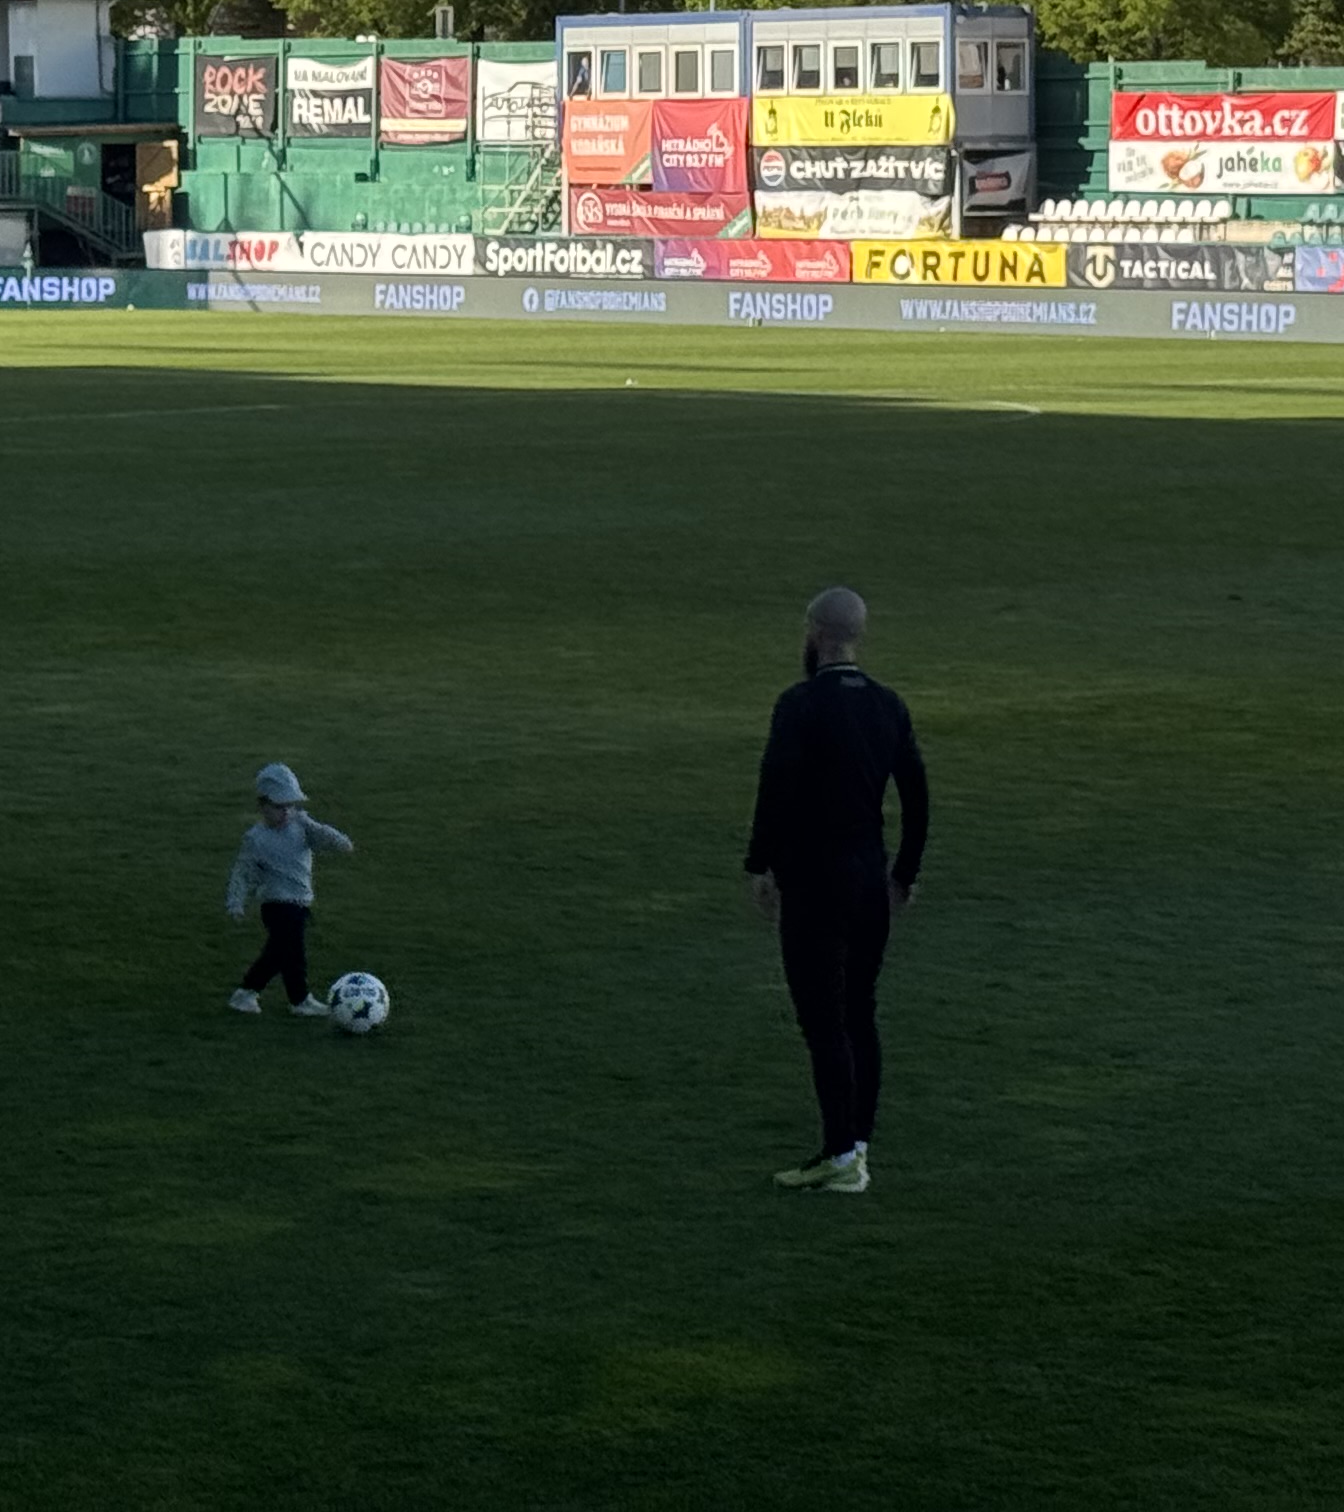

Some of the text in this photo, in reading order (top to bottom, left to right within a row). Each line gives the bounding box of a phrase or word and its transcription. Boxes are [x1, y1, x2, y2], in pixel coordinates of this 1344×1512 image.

[203, 63, 267, 94] ROCK
[204, 94, 266, 116] ZONE
[292, 96, 371, 124] REMAL
[1135, 101, 1310, 137] ottovka.cz
[662, 154, 684, 168] CITY
[708, 154, 725, 168] FM
[910, 157, 945, 181] VÍC
[310, 242, 466, 270] CANDY CANDY
[485, 241, 643, 277] SportFotbal.cz
[866, 249, 1046, 284] FORTUNA
[1120, 259, 1217, 281] TACTICAL
[374, 284, 465, 311] FANSHOP
[728, 291, 833, 321] FANSHOP
[1171, 301, 1296, 333] FANSHOP
